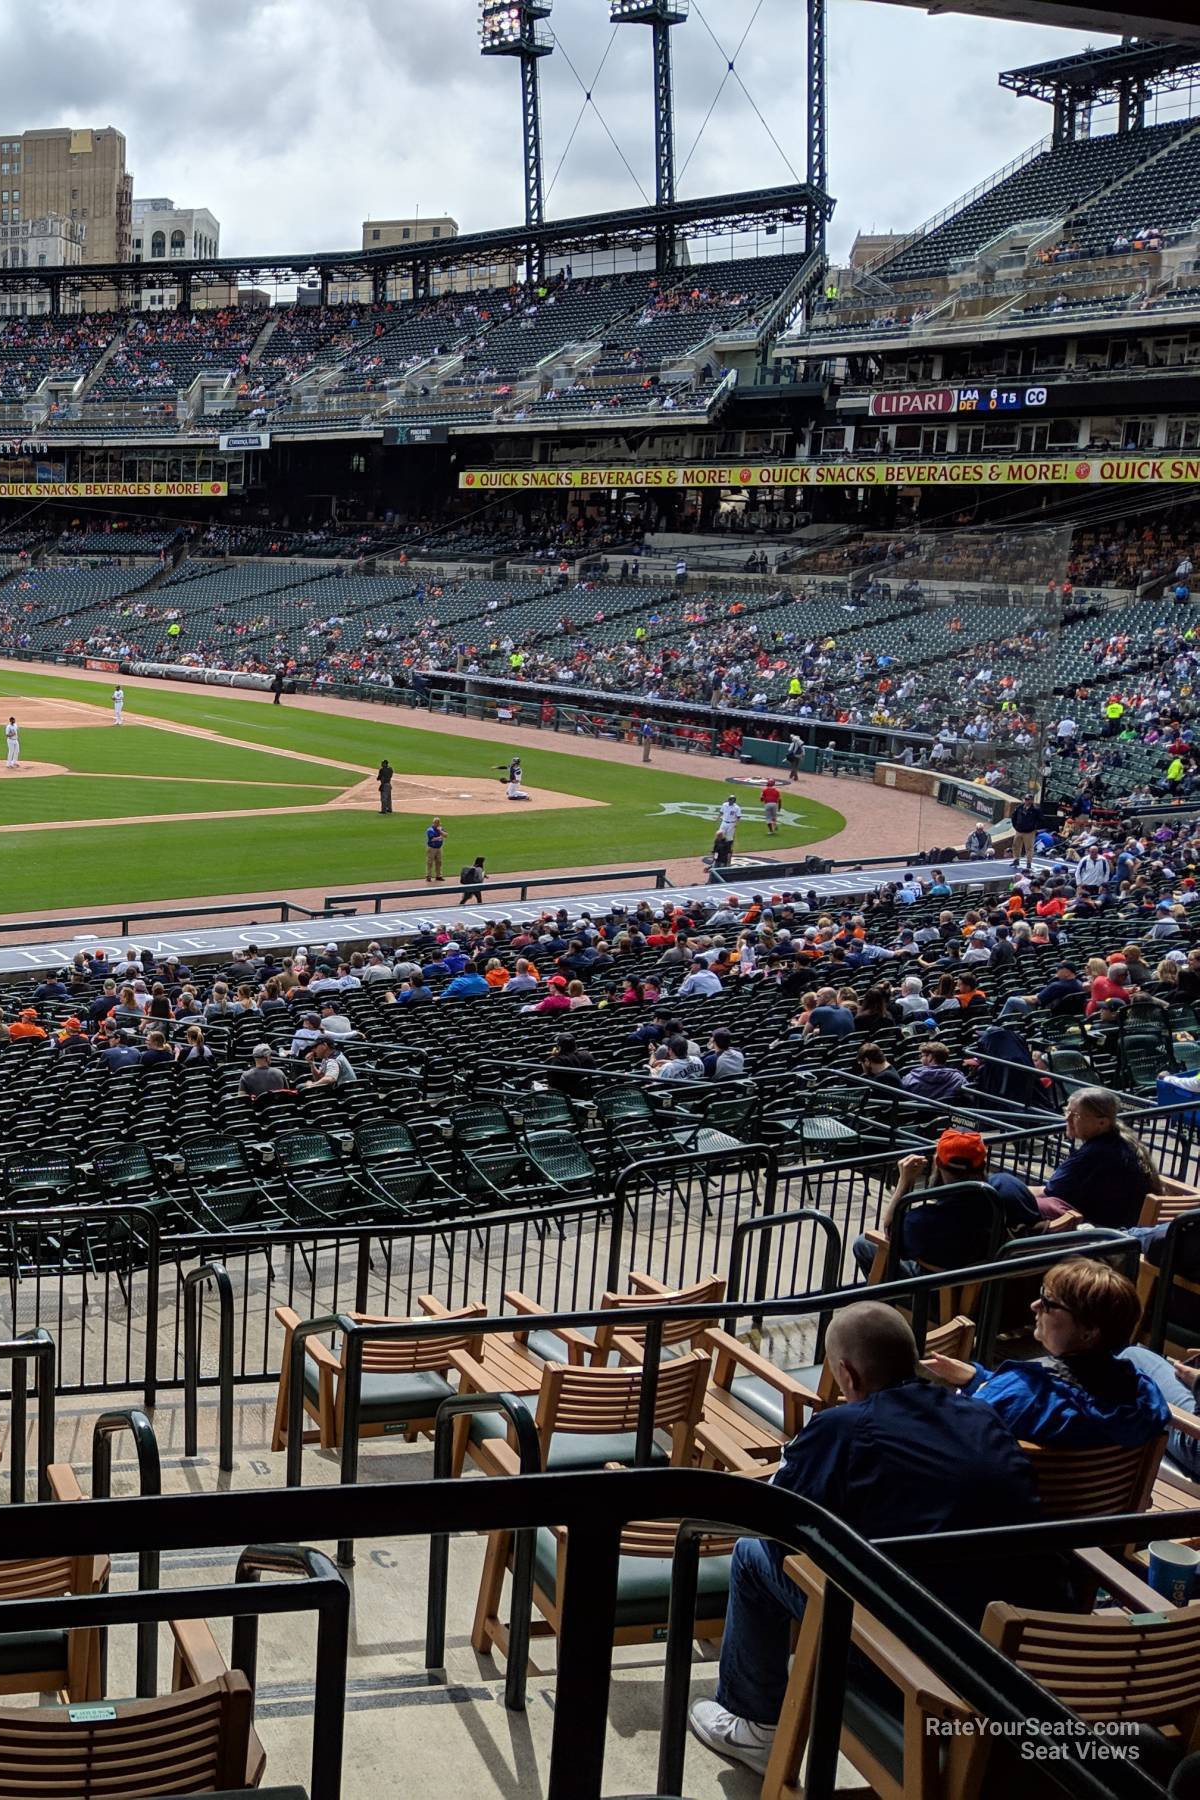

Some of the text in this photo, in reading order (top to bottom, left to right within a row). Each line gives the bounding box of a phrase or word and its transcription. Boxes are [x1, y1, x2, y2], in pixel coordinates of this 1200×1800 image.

[960, 388, 998, 401] LAA 6
[881, 393, 943, 413] LIPARI
[959, 400, 978, 411] DET
[22, 442, 48, 454] CLUB
[480, 468, 733, 488] QUICK SNACKS, BEVERAGES & MORE!
[759, 462, 1069, 484] QUICK SNACKS, BEVERAGES & MORE!
[1099, 461, 1164, 481] QUICK
[0, 483, 203, 497] QUICK SNACKS, BEVERAGES & MORE!
[249, 1460, 272, 1475] B
